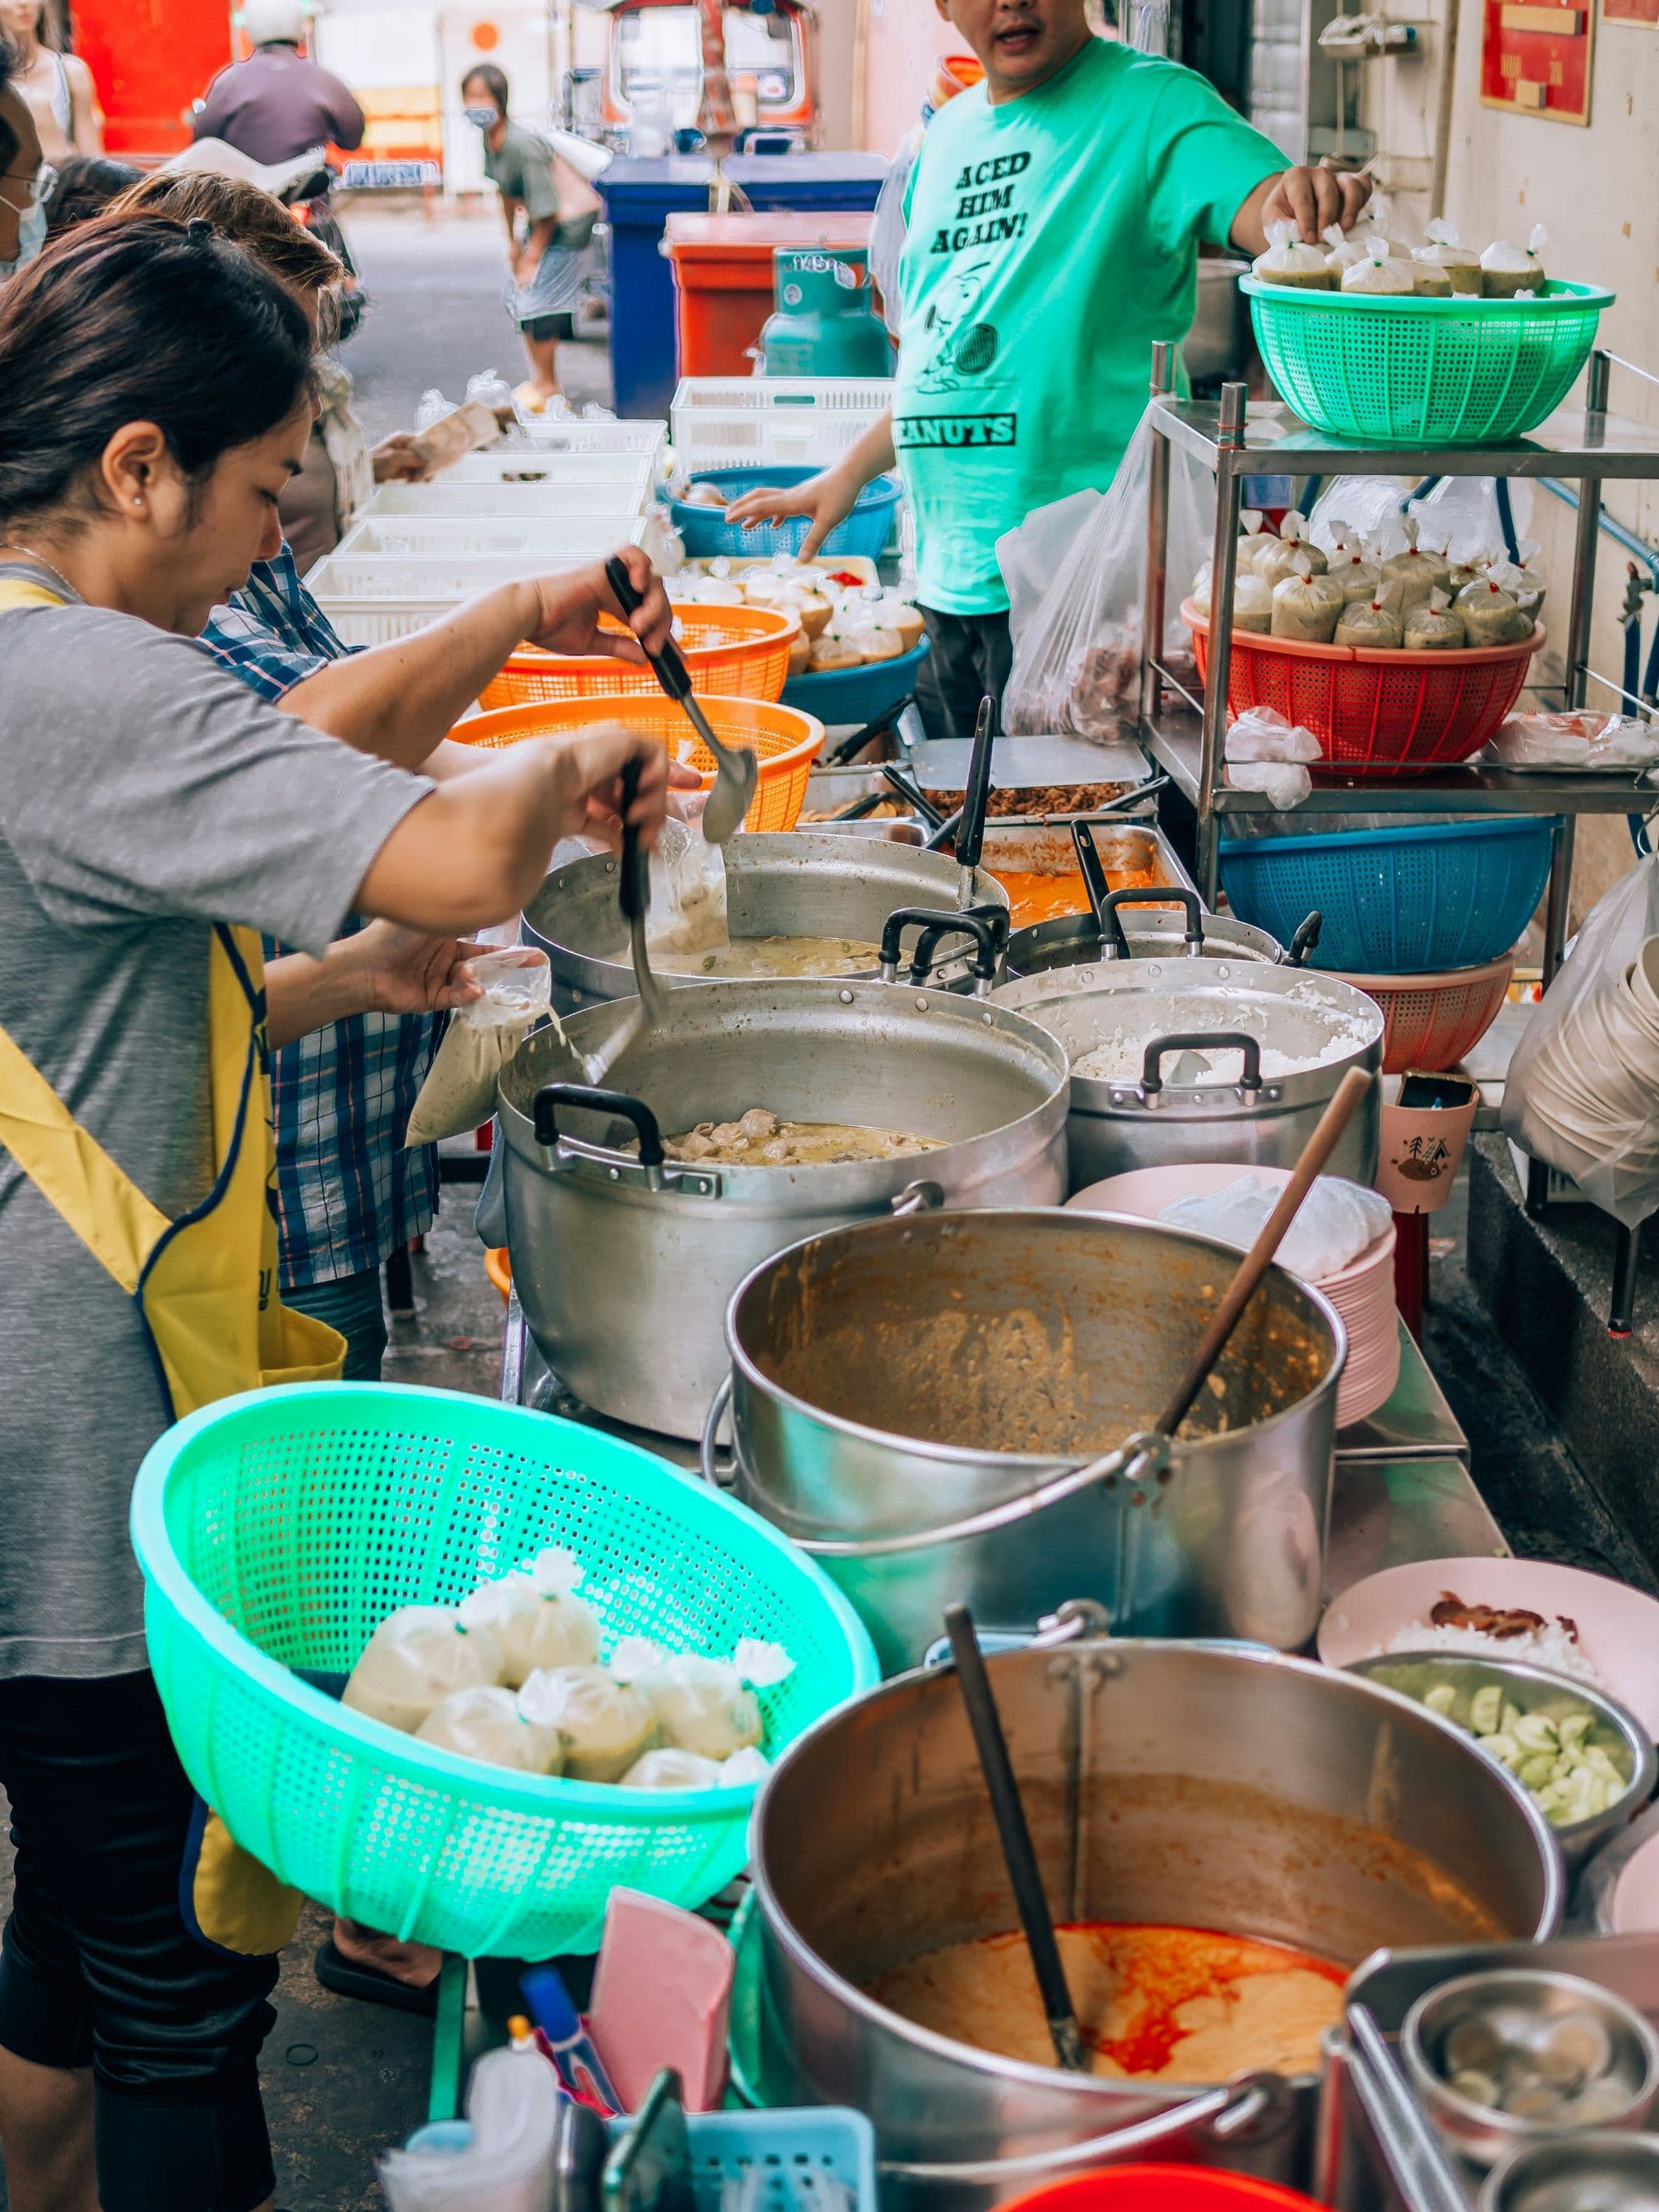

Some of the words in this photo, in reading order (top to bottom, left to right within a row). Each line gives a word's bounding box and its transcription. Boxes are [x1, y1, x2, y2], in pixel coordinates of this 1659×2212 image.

[956, 152, 1031, 189] ACED
[956, 185, 1015, 219] HIM
[931, 213, 1029, 253] AGAIN!
